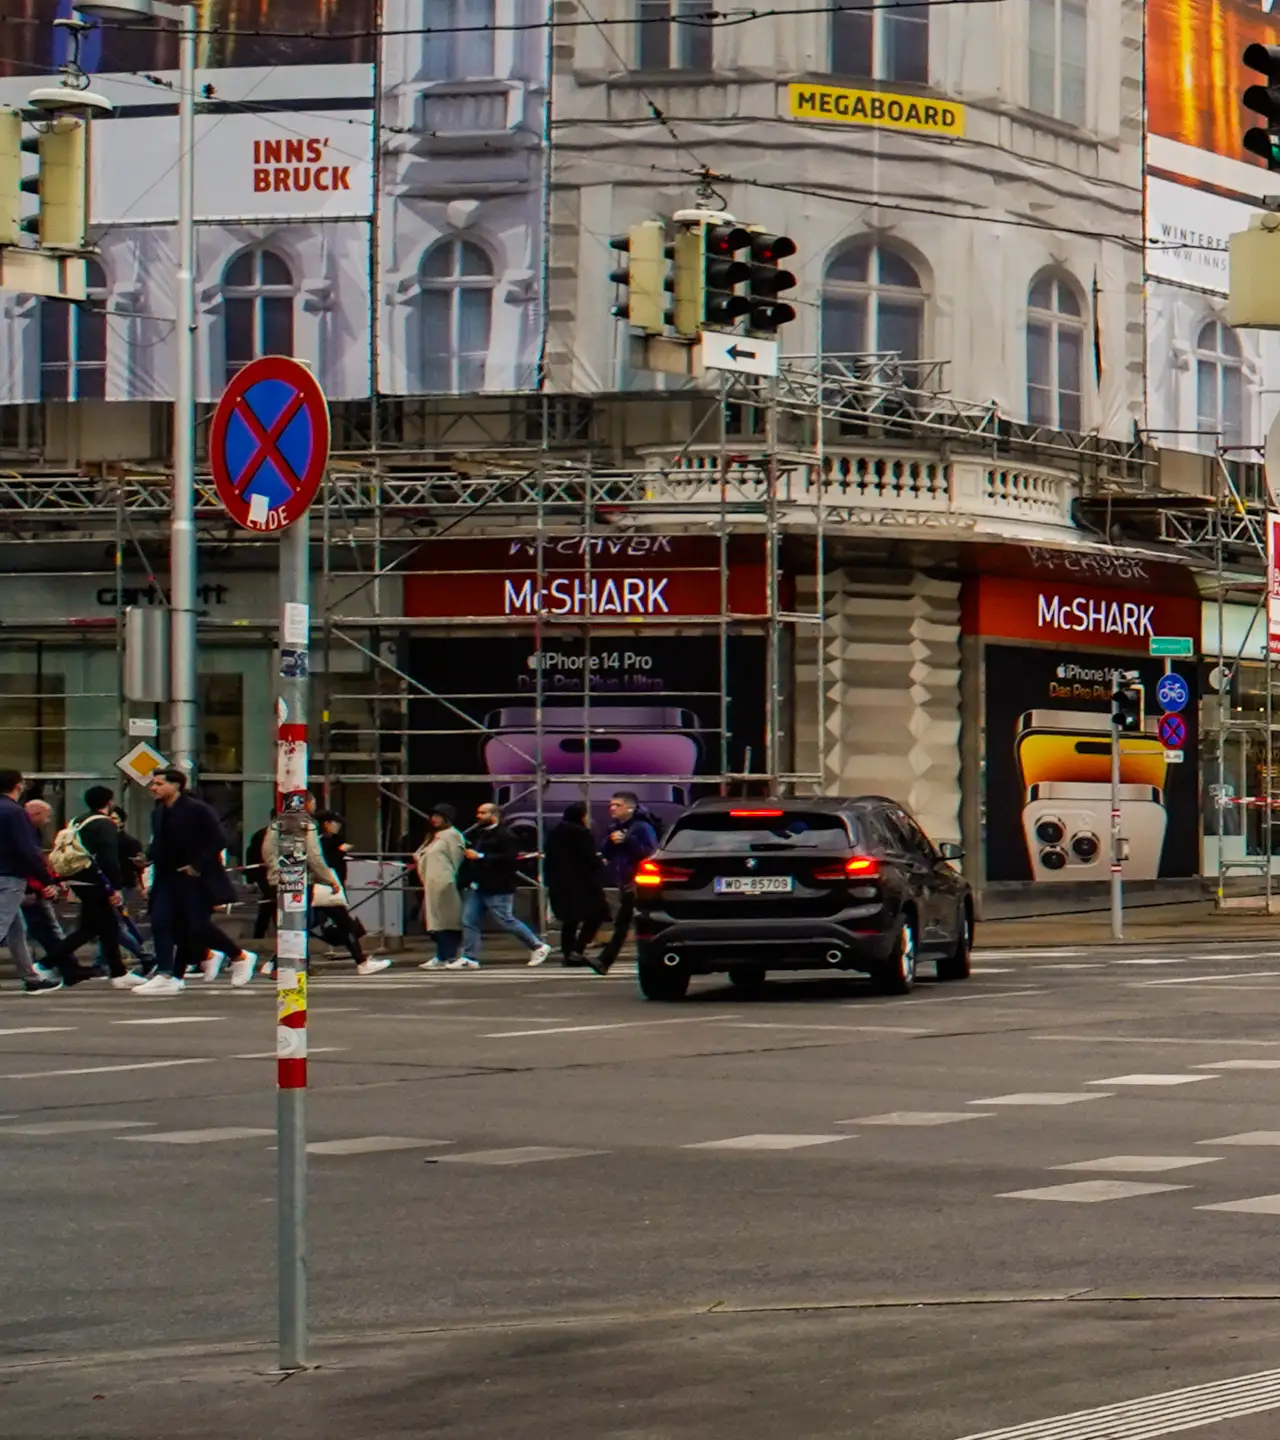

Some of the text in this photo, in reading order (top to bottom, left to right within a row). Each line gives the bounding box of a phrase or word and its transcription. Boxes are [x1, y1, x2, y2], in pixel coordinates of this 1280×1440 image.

[798, 91, 955, 127] MEGABOARD
[254, 137, 329, 164] INNS'
[254, 166, 350, 192] BRUCK
[504, 578, 669, 613] McSHARK
[1038, 593, 1155, 637] McSHARK
[541, 652, 652, 669] iPhone 14 Pro
[1065, 663, 1103, 682] iPhone
[1050, 681, 1113, 699] Das Pro Plu
